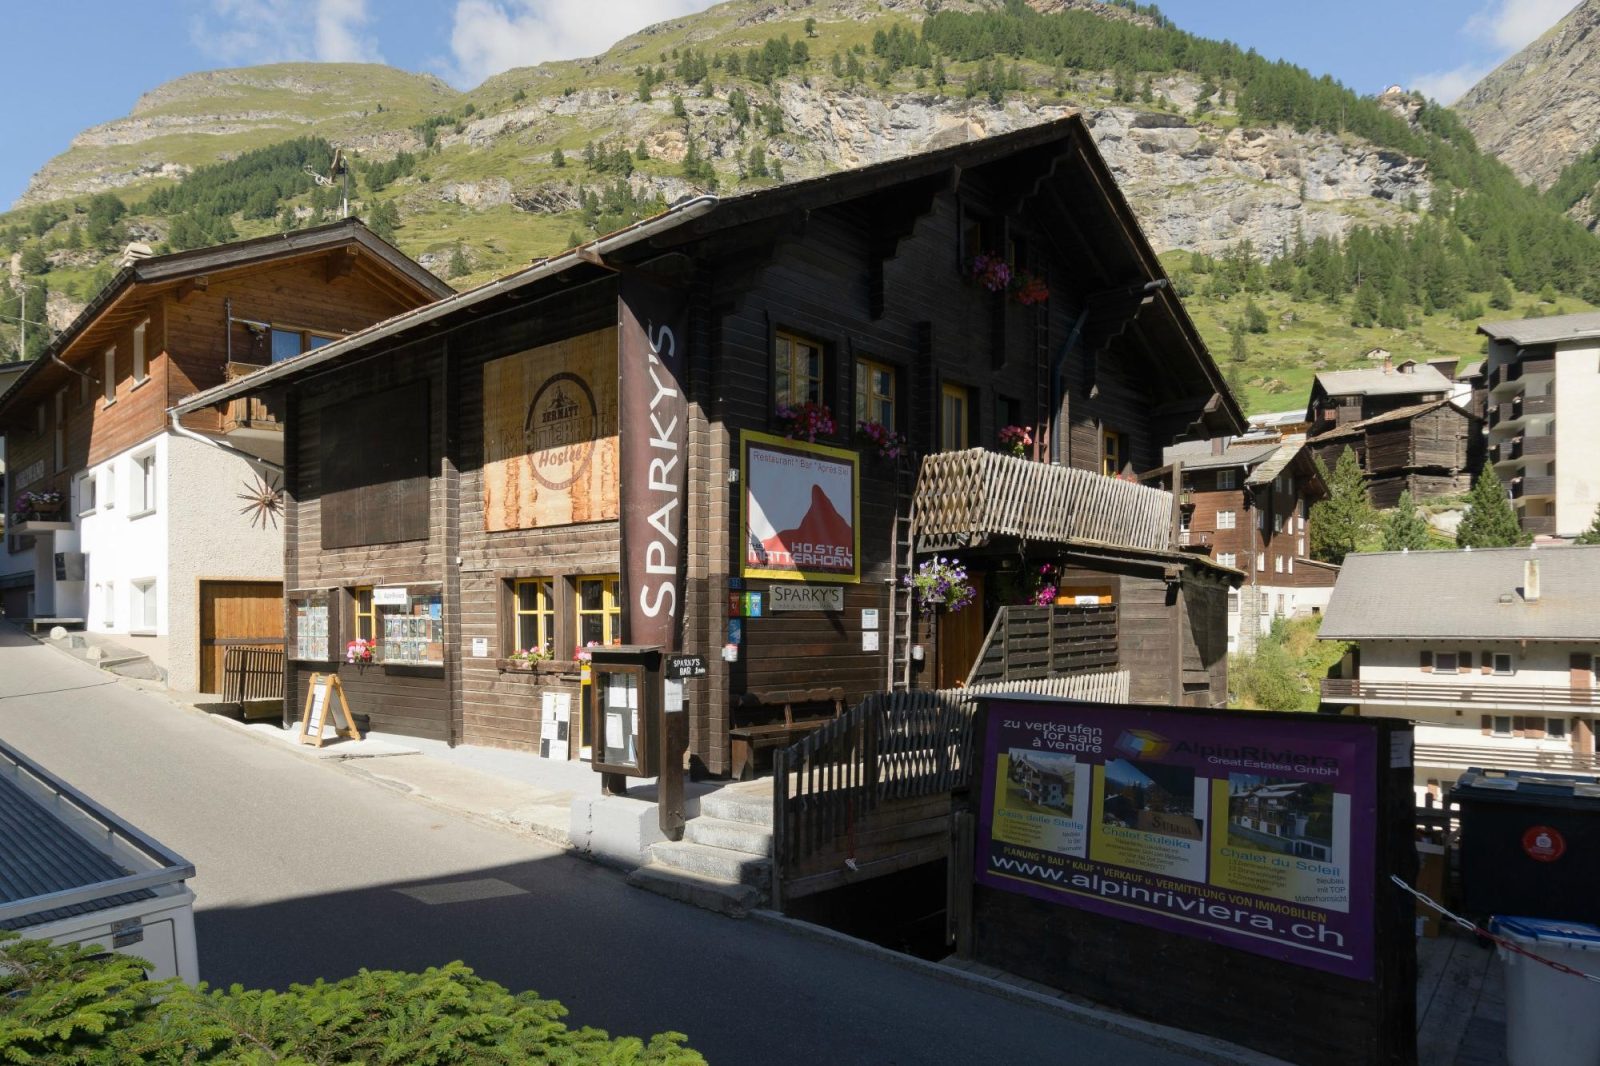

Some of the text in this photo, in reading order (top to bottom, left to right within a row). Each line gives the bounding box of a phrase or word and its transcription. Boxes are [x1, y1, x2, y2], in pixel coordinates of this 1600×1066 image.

[539, 445, 583, 468] Hostel
[753, 451, 794, 467] Restaurant
[800, 459, 813, 469] Bar
[838, 466, 849, 476] Ski
[640, 323, 678, 617] SPARKY'S
[748, 550, 853, 568] MATTERHORN
[791, 542, 853, 558] HOSTEL
[774, 586, 839, 602] SPARKY'S
[673, 658, 701, 668] SPARKY'S
[679, 666, 692, 676] BAR
[1003, 719, 1102, 736] zu verkaufen
[1043, 730, 1102, 745] for sale
[1032, 738, 1102, 754] à vendre
[1174, 740, 1339, 768] AlpinRiviera
[1207, 755, 1339, 777] Great Estates GmbH
[1103, 826, 1141, 838] Chalet
[1143, 832, 1191, 849] Suleika
[1220, 847, 1267, 863] Chalet
[1271, 857, 1290, 868] du
[1295, 861, 1340, 877] Soleil
[1003, 846, 1040, 861] PLANUNG
[1047, 855, 1065, 867] BAU
[1072, 860, 1095, 873] KAUF
[1103, 866, 1144, 883] VERKAUF
[1156, 879, 1226, 902] VERMITTLUNG
[1228, 893, 1253, 907] VON
[1255, 897, 1328, 923] IMMOBILIEN
[1330, 886, 1346, 894] TOP
[991, 855, 1344, 947] www.alpinriviera.ch
